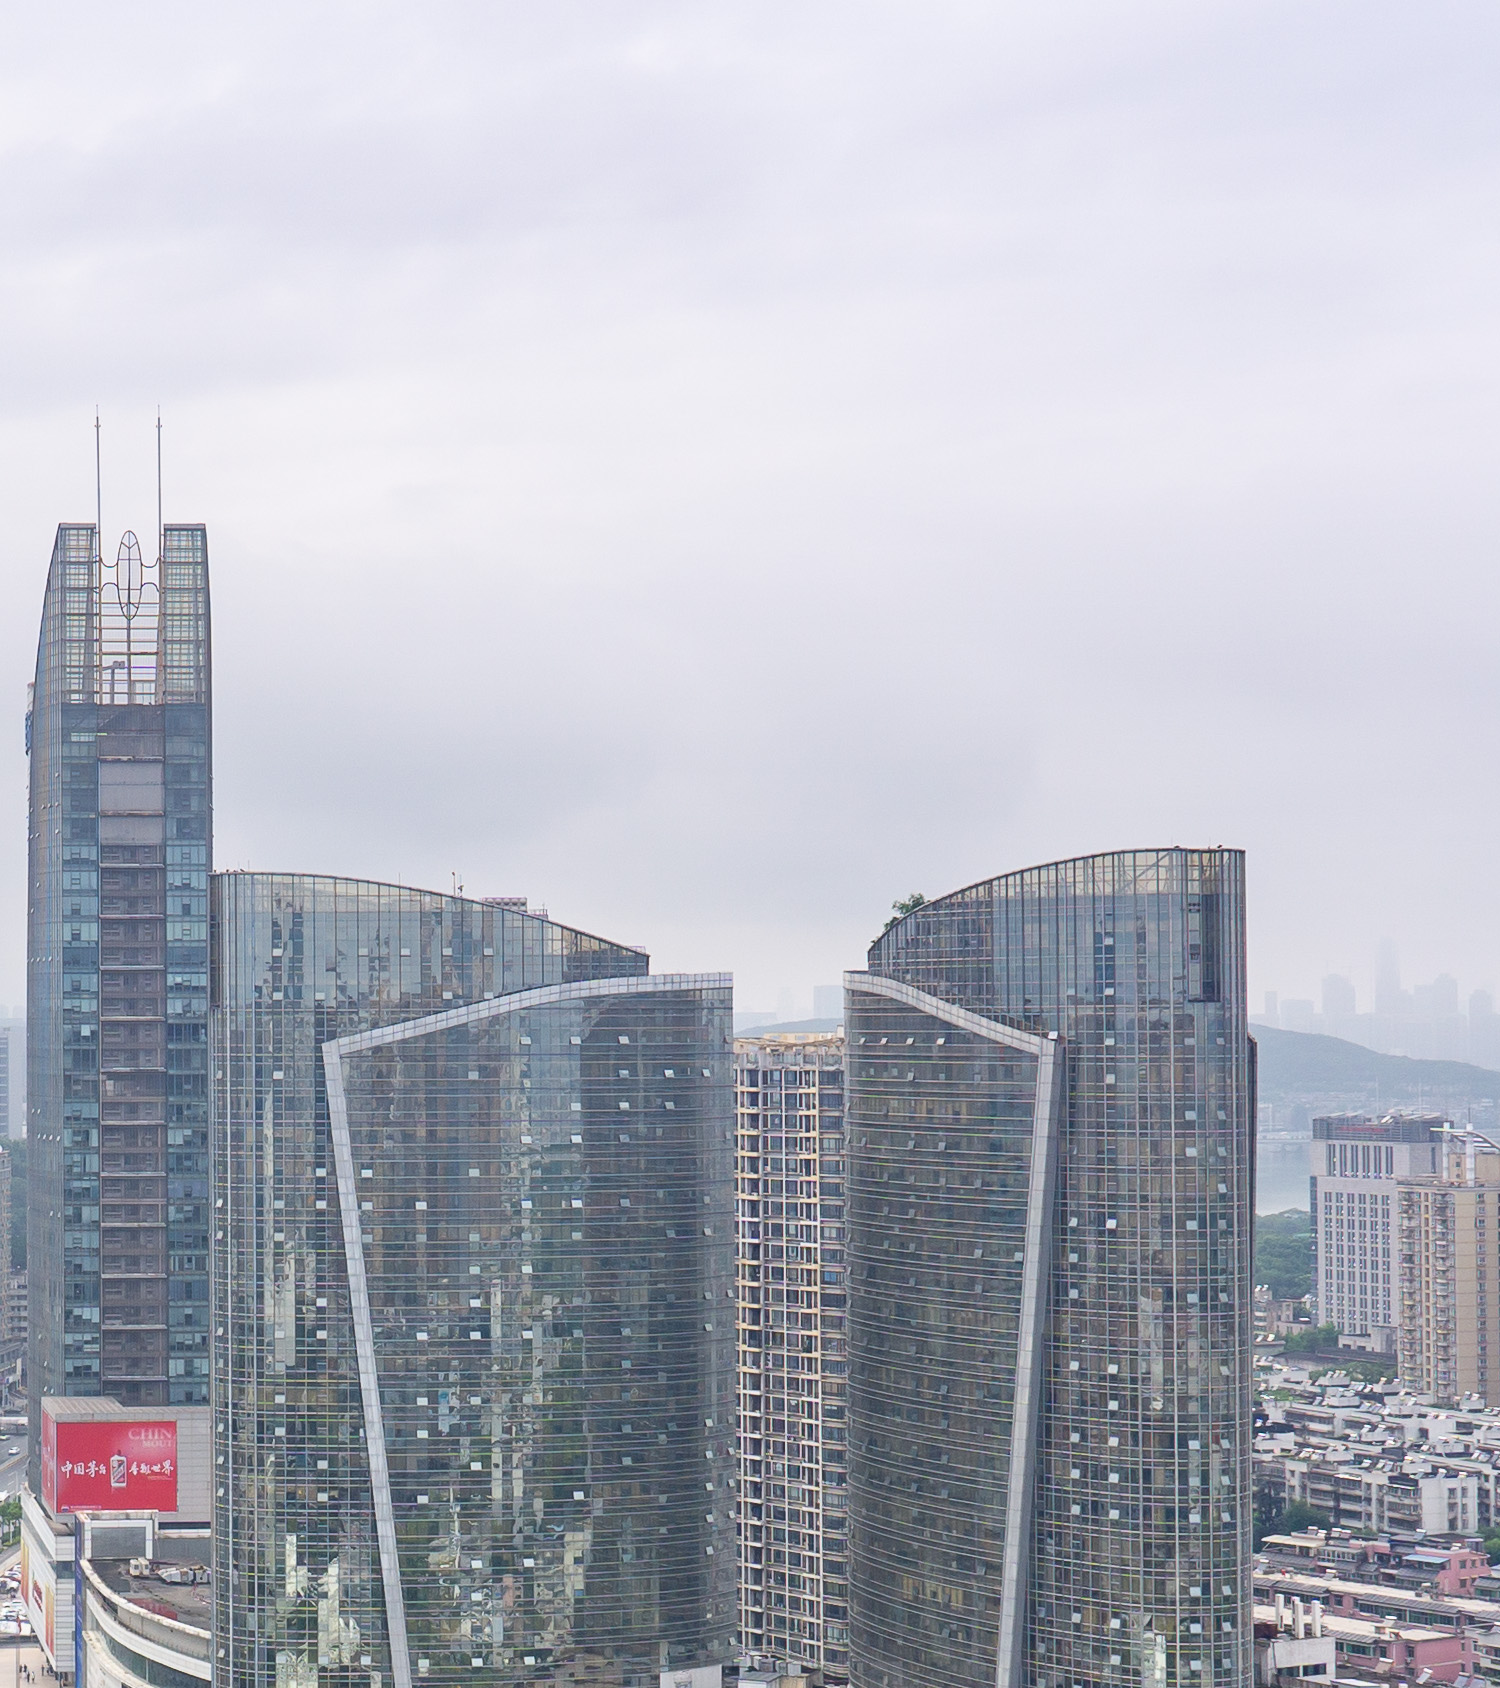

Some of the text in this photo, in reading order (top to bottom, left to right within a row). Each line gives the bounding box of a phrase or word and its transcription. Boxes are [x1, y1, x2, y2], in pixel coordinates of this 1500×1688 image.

[128, 1428, 176, 1441] CHIN
[60, 1460, 107, 1479] 中国茅台
